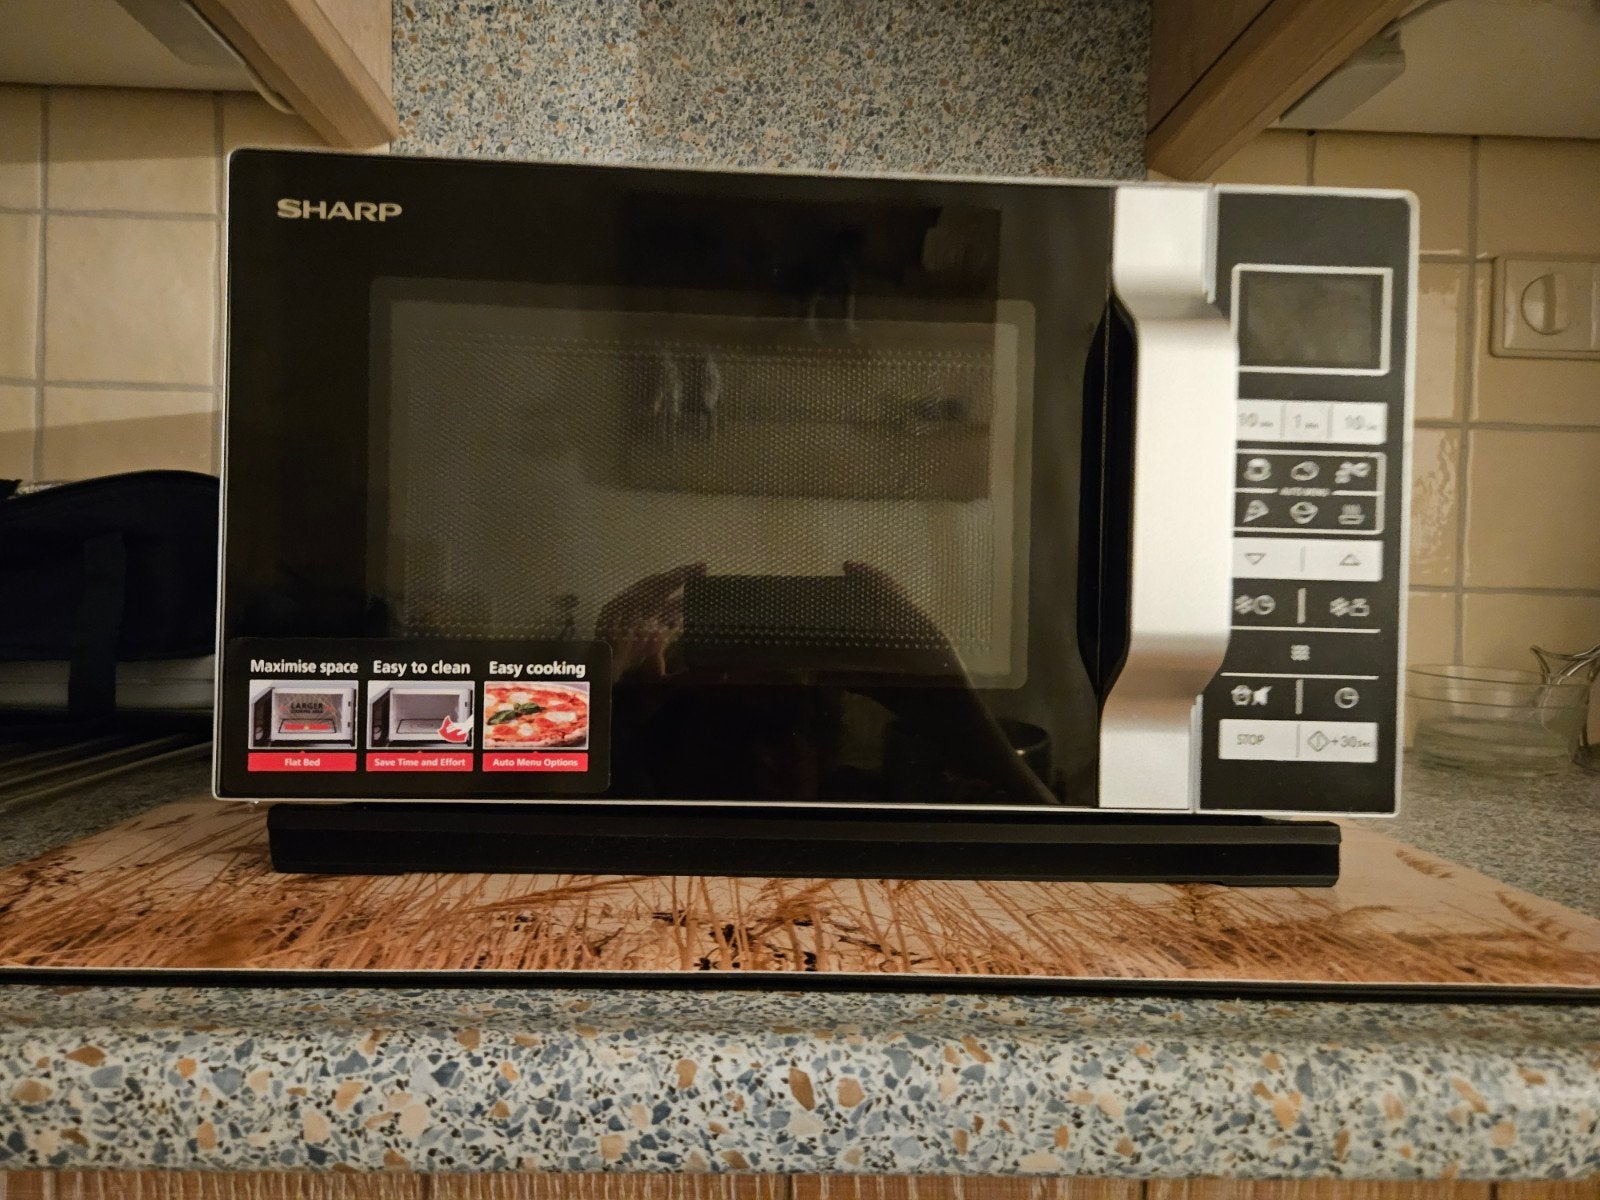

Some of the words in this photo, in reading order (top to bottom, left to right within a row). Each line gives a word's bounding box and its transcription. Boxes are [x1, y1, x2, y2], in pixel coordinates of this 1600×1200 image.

[277, 198, 402, 222] SHARP
[250, 659, 316, 674] Maximise
[319, 661, 359, 676] space
[373, 660, 407, 677] Easy
[411, 661, 428, 674] to
[431, 660, 471, 674] clean
[489, 661, 523, 678] Easy
[526, 661, 586, 678] cooking
[291, 702, 324, 710] LARGER
[1236, 733, 1265, 746] STOP
[284, 758, 301, 767] Flat
[303, 758, 321, 767] Bed
[374, 758, 396, 767] Save
[397, 758, 419, 767] Time
[421, 758, 438, 767] and
[440, 758, 466, 767] Effort
[492, 758, 515, 767] Auto
[516, 758, 542, 767] Menu
[543, 758, 578, 768] Options
